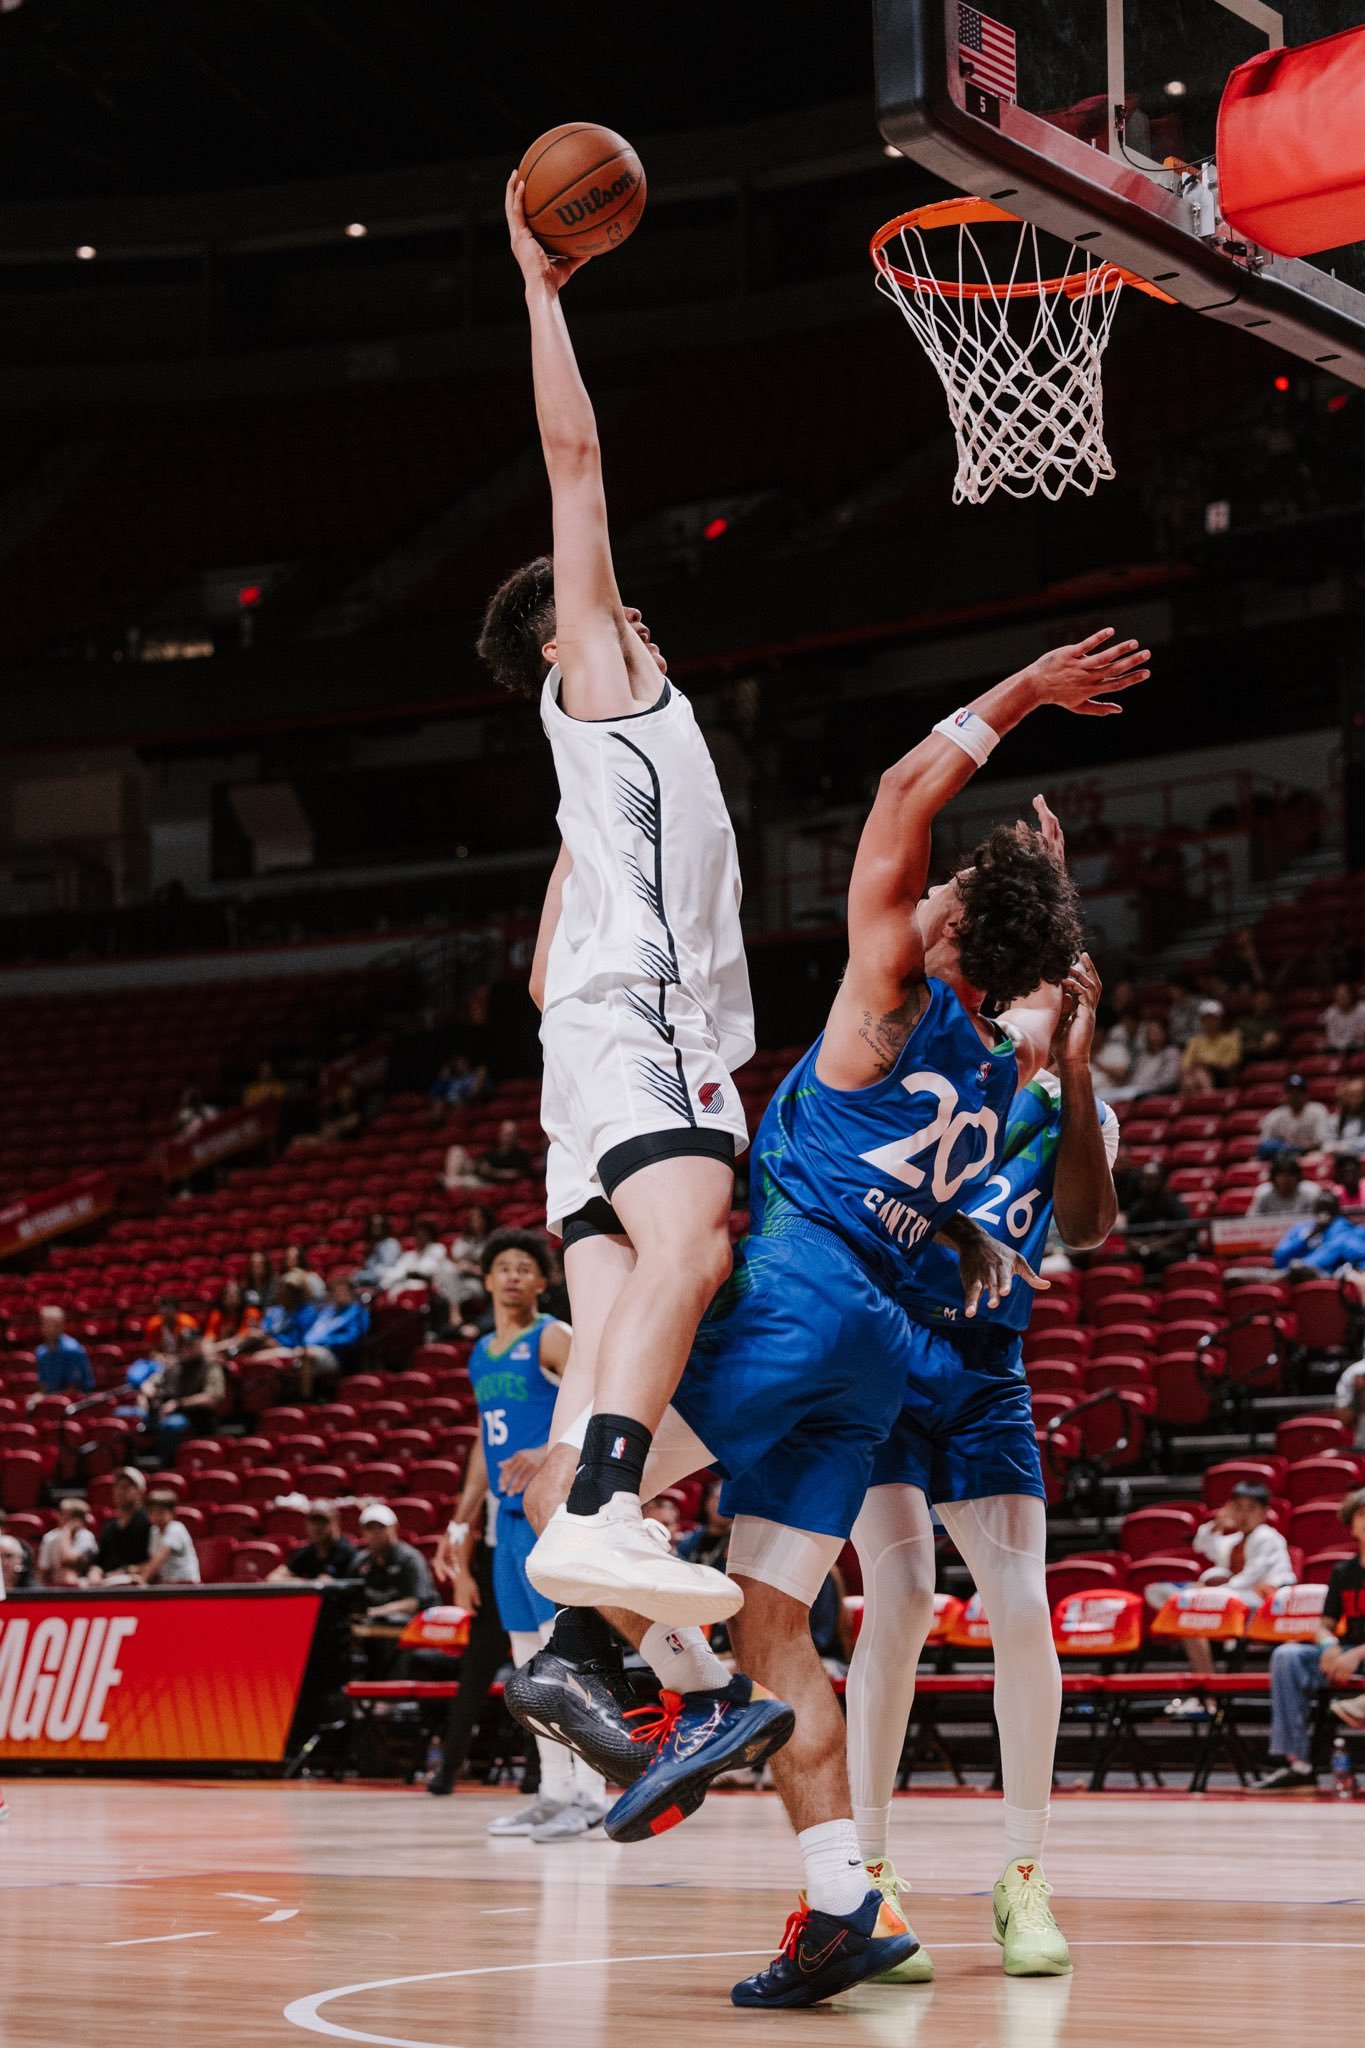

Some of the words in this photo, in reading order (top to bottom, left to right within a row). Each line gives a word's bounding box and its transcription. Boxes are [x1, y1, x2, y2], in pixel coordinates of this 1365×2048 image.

[980, 95, 986, 113] 5
[554, 170, 637, 226] Wilson
[858, 1071, 999, 1203] 20
[863, 1187, 932, 1249] SANTO
[966, 1175, 1042, 1239] 26
[484, 1408, 509, 1446] 15
[0, 1616, 138, 1742] AGUE
